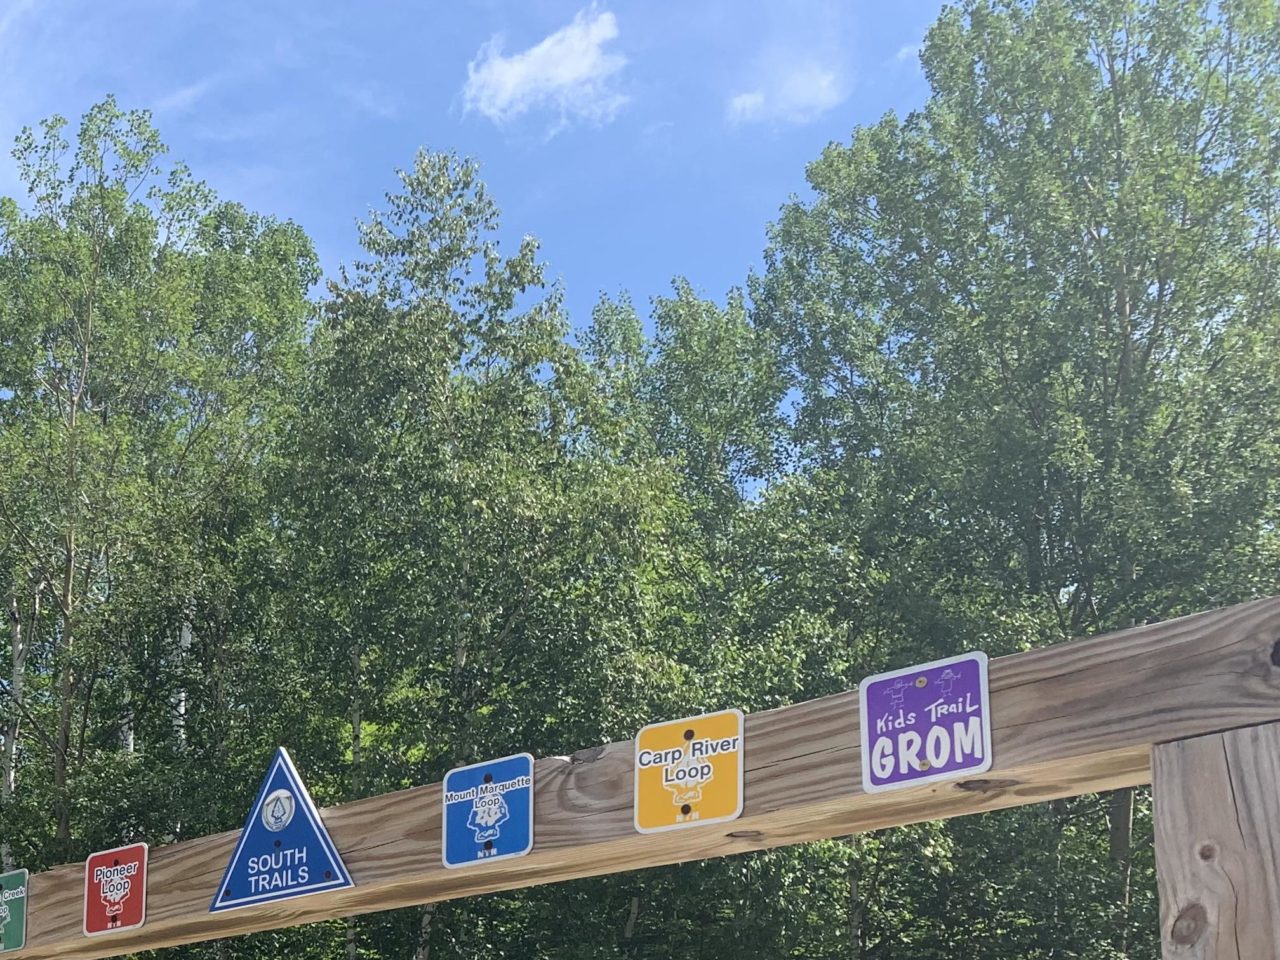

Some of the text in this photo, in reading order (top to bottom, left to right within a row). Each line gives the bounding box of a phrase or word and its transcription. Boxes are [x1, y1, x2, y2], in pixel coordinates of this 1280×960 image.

[876, 709, 917, 734] Kids
[639, 737, 739, 767] Carp River
[871, 716, 983, 779] GROM
[664, 764, 711, 783] Loop
[445, 777, 531, 803] Mount Marquette
[474, 797, 500, 808] Loop
[95, 863, 138, 881] Pioneer
[248, 846, 307, 874] SOUTH
[102, 880, 130, 894] Loop
[248, 866, 309, 893] TRAILS
[3, 888, 26, 900] Creek
